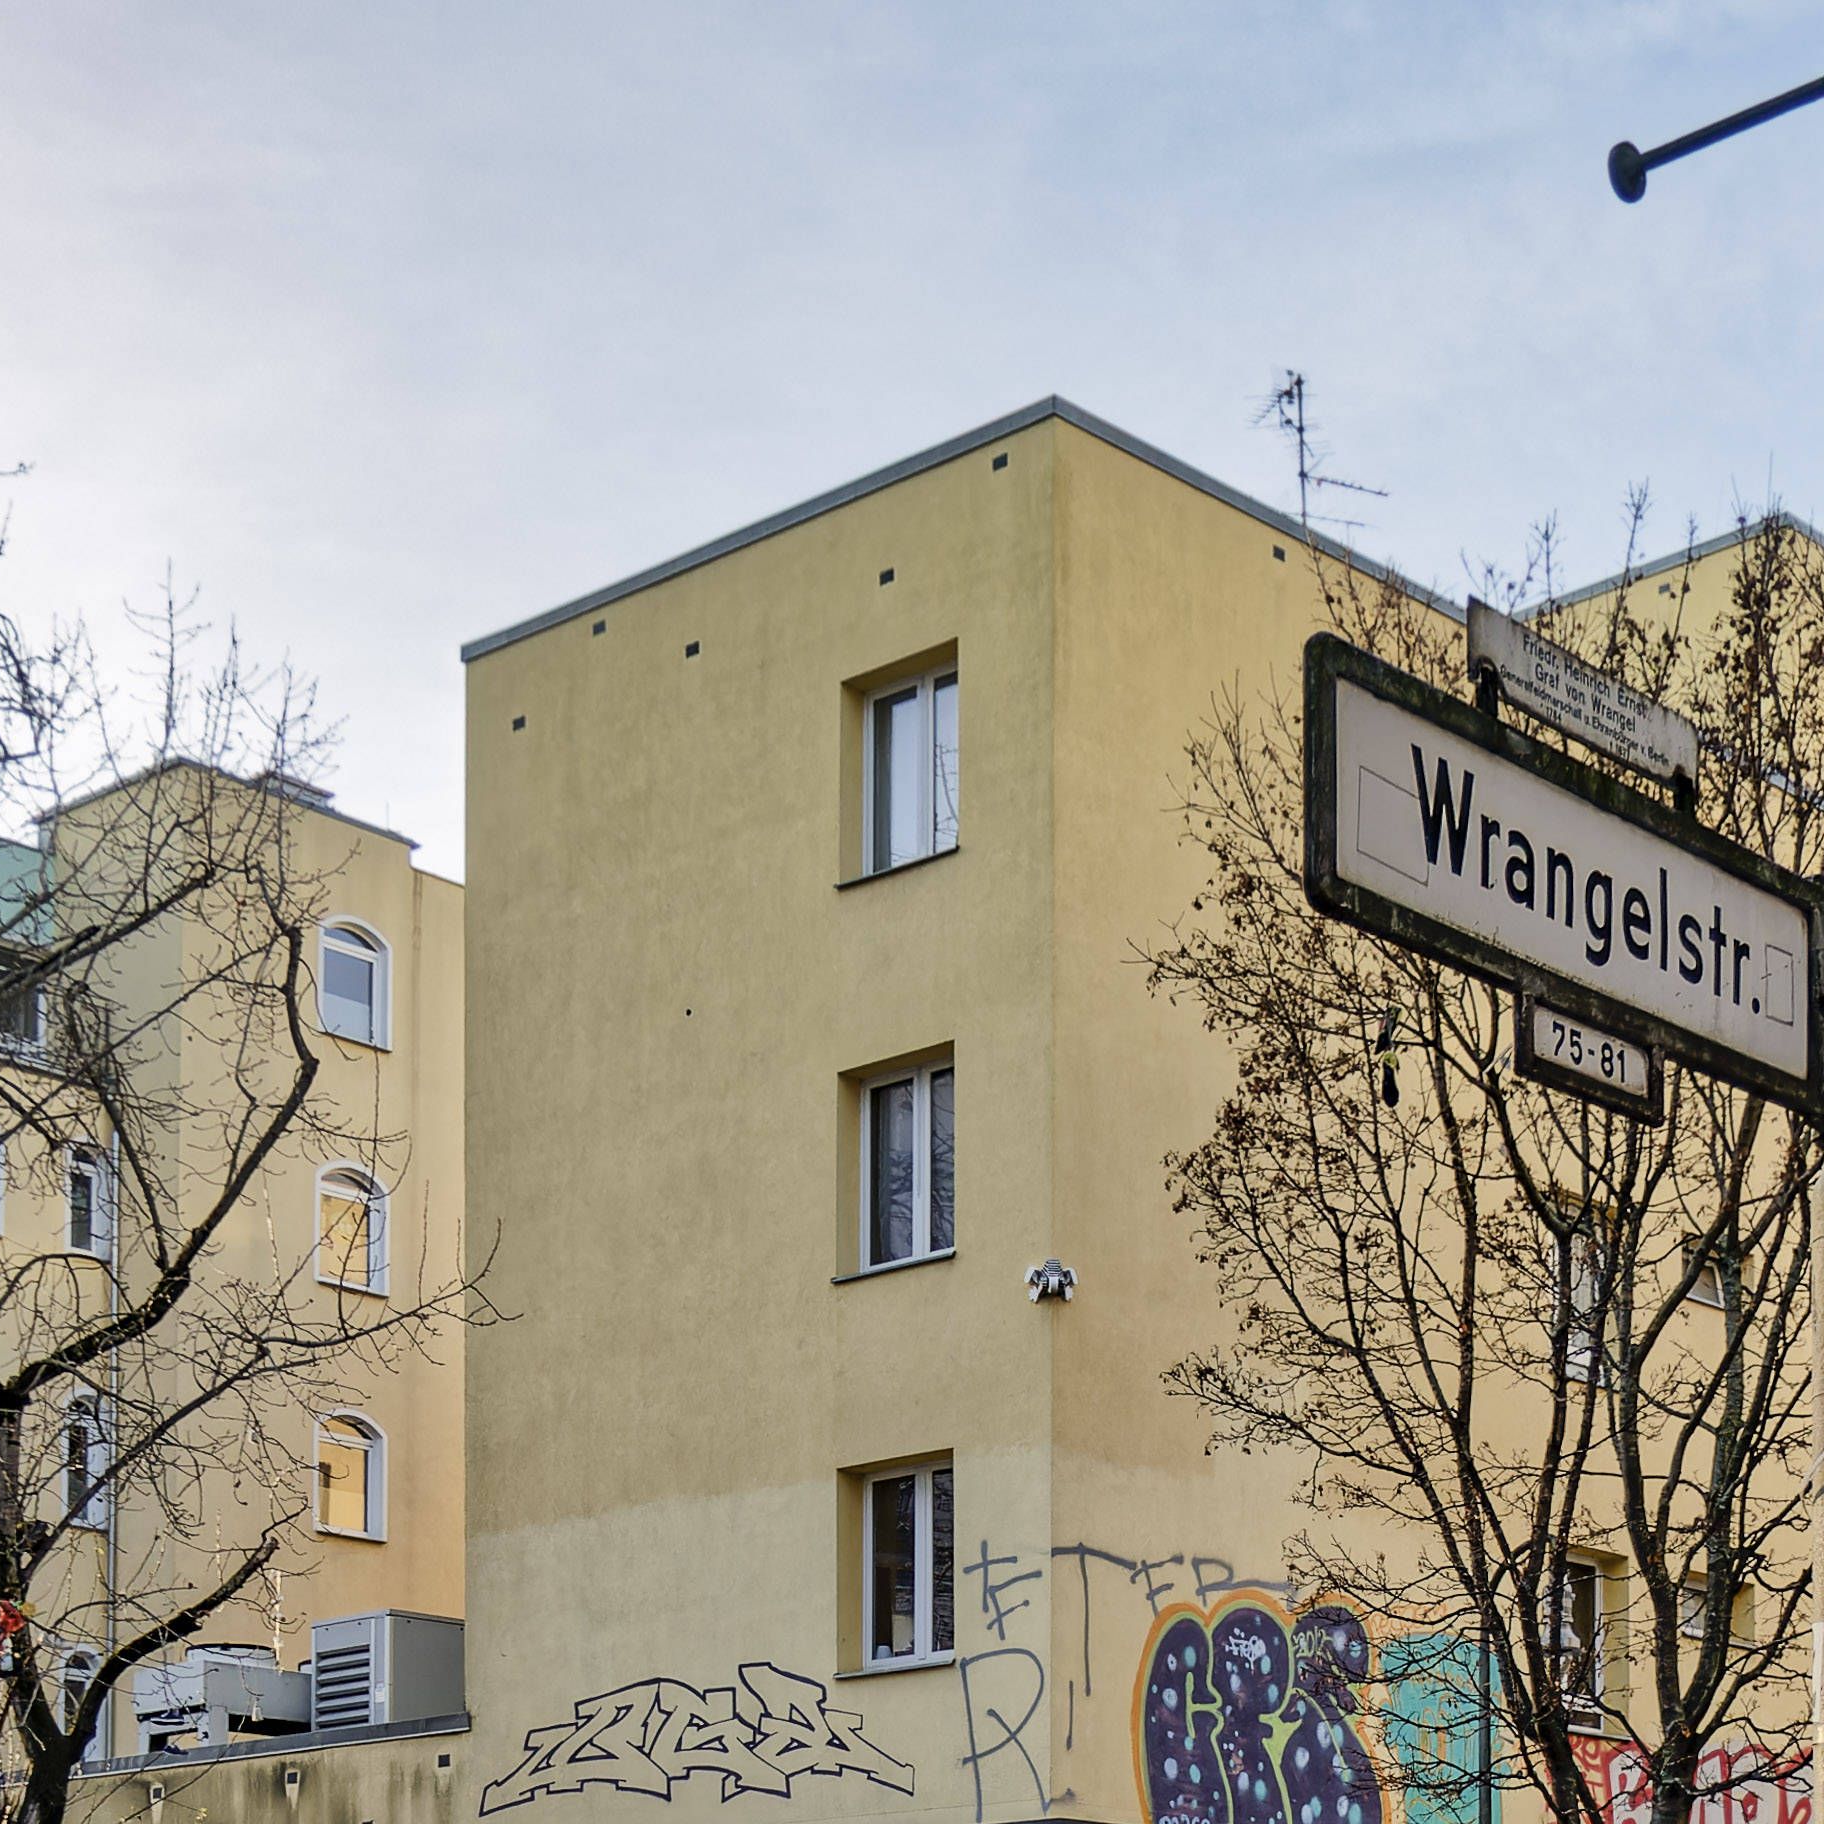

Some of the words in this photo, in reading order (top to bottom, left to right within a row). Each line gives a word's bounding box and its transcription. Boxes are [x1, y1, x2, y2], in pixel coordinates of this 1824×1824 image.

[1534, 662, 1560, 691] Graf
[1565, 683, 1585, 704] von
[1591, 694, 1636, 732] Wrangel
[1564, 660, 1610, 698] Heinrich
[1410, 743, 1763, 1015] Wrangelstr.
[1551, 1018, 1628, 1084] 75-81
